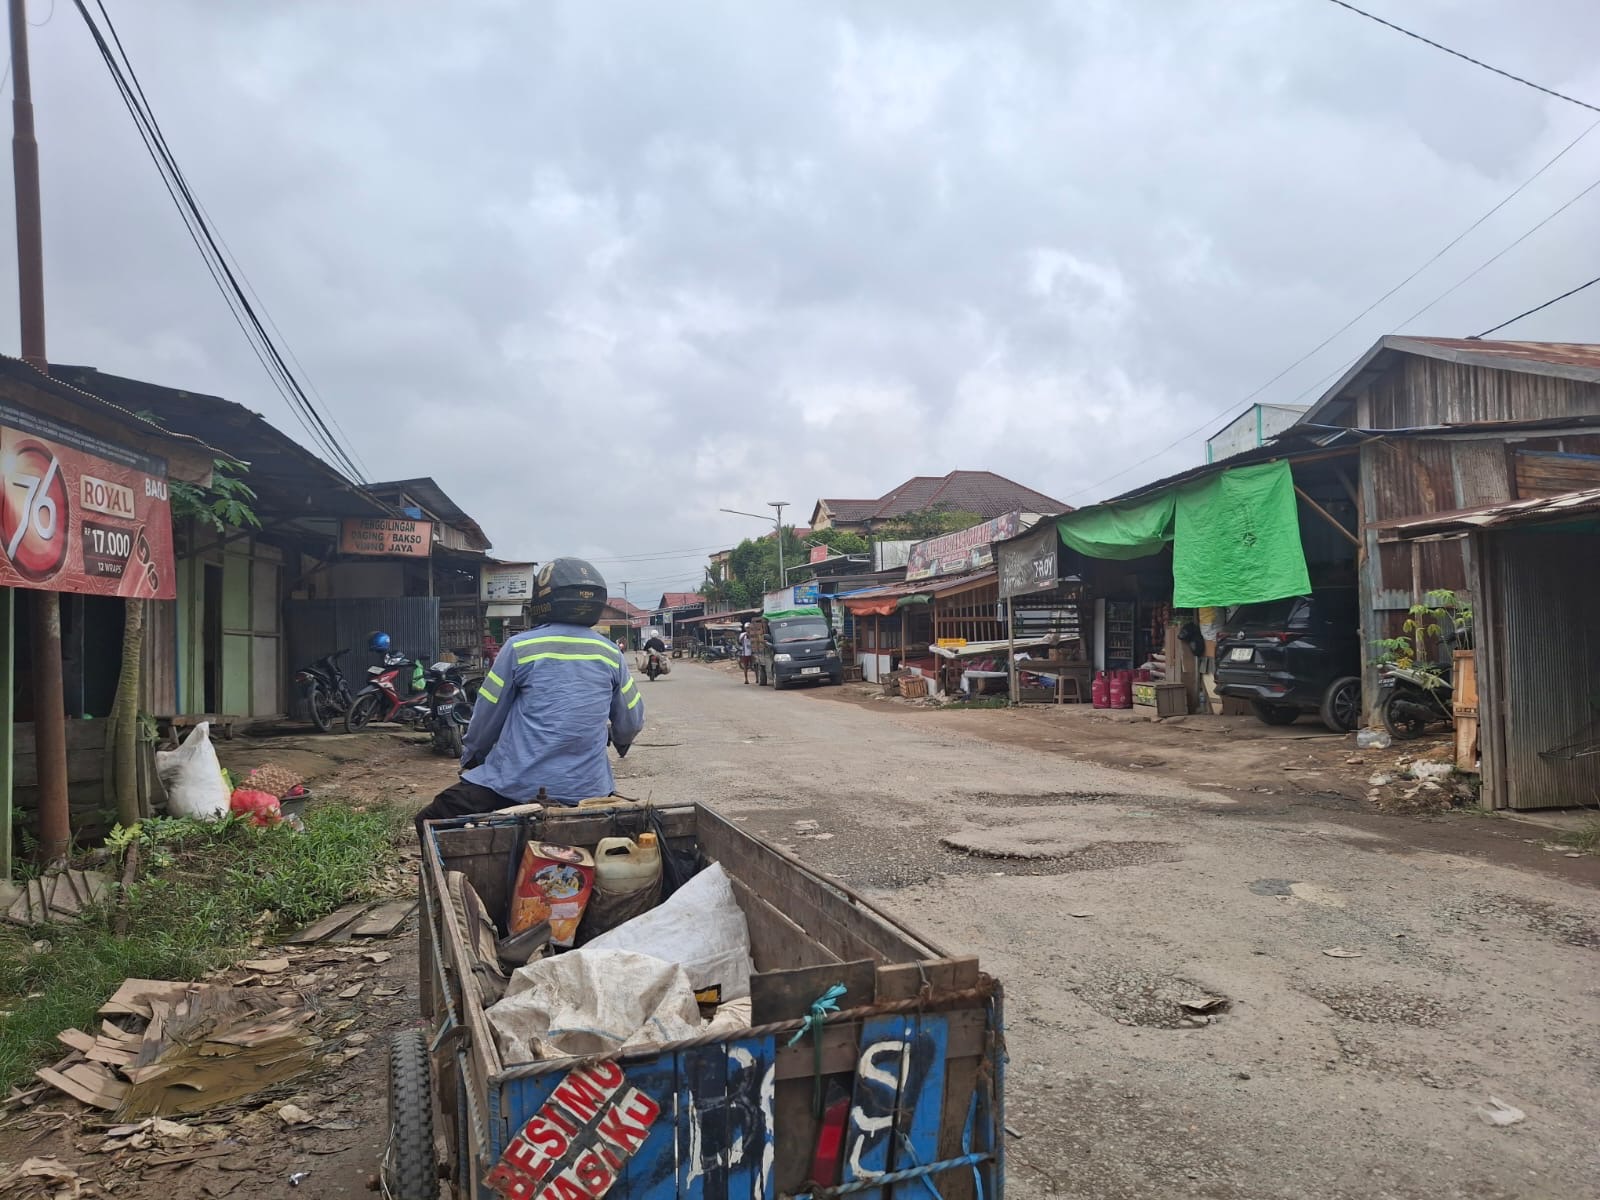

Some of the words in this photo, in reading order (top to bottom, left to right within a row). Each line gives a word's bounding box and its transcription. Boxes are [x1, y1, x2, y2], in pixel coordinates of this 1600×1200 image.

[7, 456, 59, 561] 76
[84, 480, 132, 513] ROYAL
[92, 529, 130, 558] 17.000
[388, 543, 414, 553] JAYA
[392, 533, 422, 544] BAKSO
[98, 562, 105, 571] 12
[105, 563, 122, 574] WRAPS
[1033, 554, 1054, 578] TROY
[599, 1092, 662, 1156] KU
[486, 1103, 580, 1200] BESI
